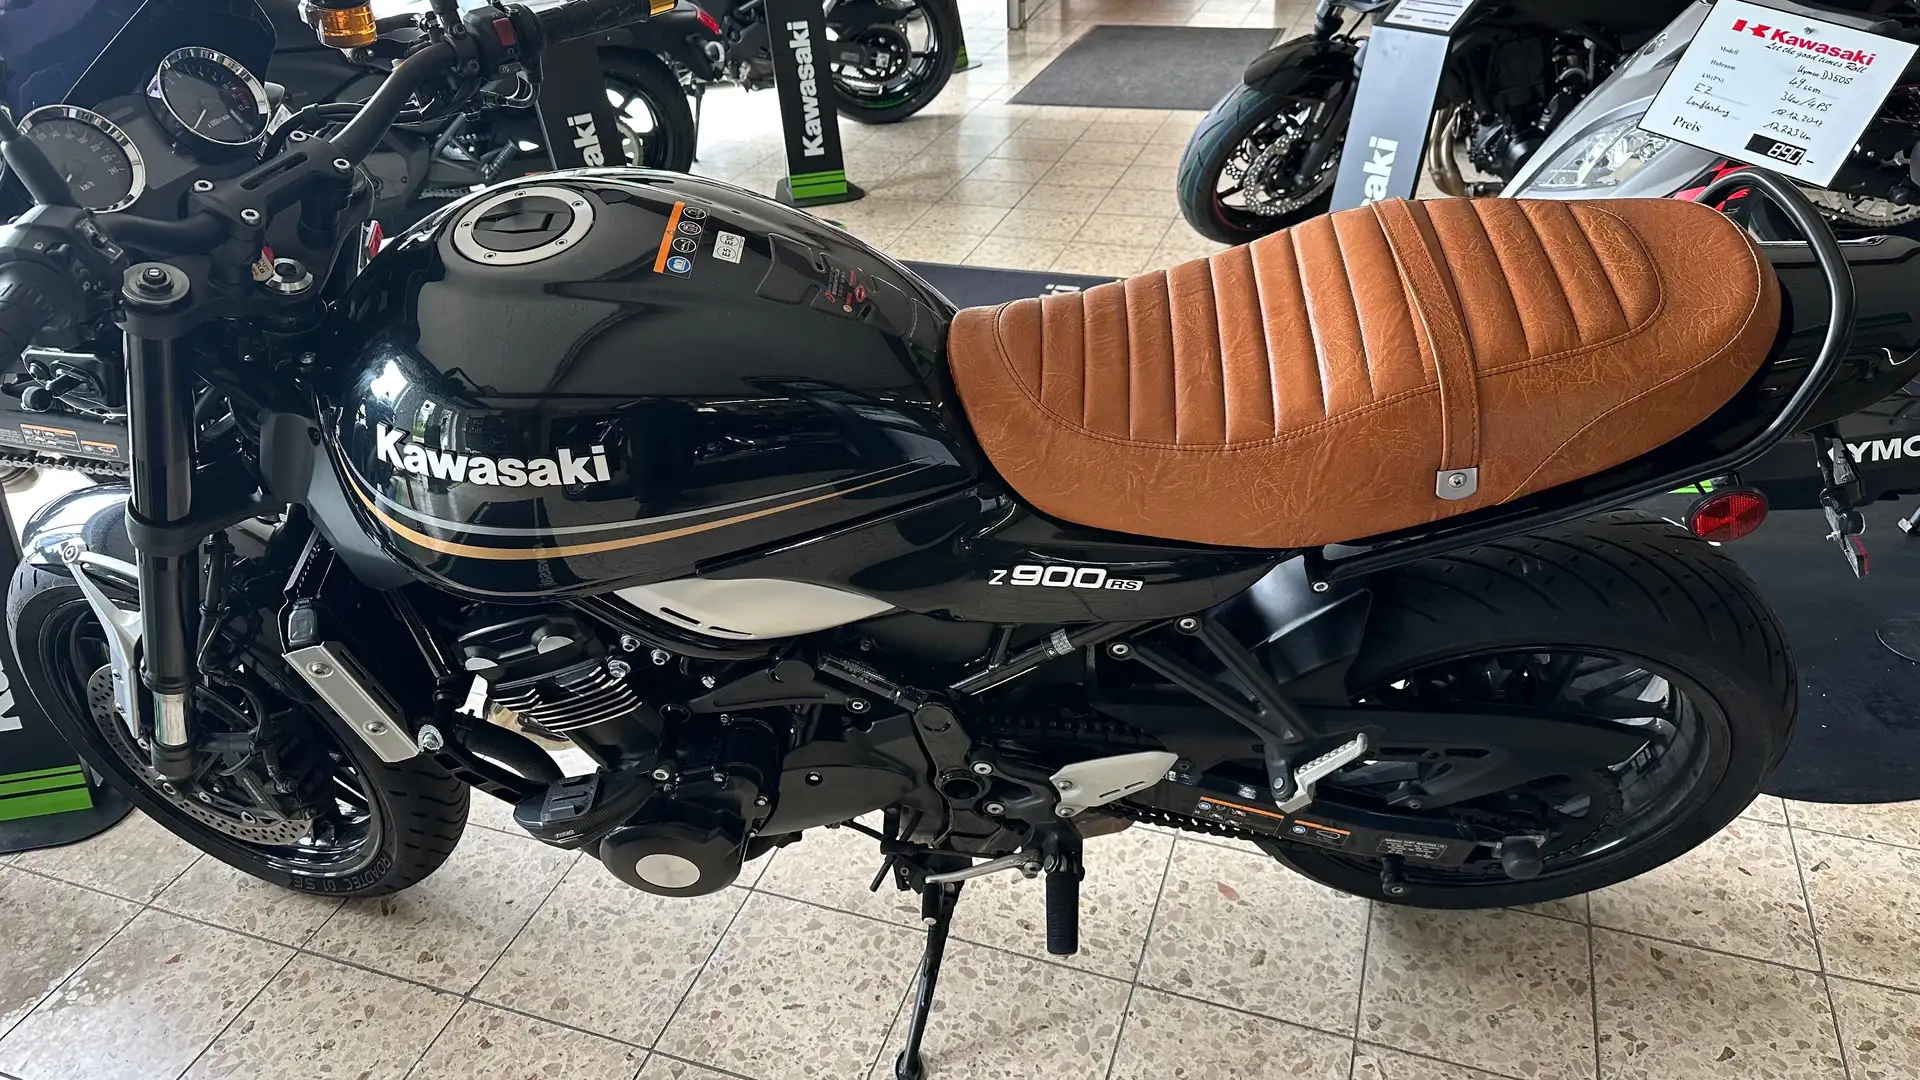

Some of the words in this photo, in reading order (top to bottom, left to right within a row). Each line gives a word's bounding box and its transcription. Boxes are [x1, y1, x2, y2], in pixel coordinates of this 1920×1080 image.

[1765, 42, 1781, 51] Let
[1782, 46, 1796, 55] the
[1796, 52, 1820, 60] good
[1818, 56, 1843, 67] times
[1844, 62, 1868, 73] Roll
[1770, 29, 1877, 66] Kawasaki
[786, 20, 825, 157] Kawasaki
[1672, 115, 1702, 132] Preis
[1360, 136, 1399, 207] aki
[376, 421, 611, 488] Kawasaki
[344, 853, 391, 891] ROADTEC
